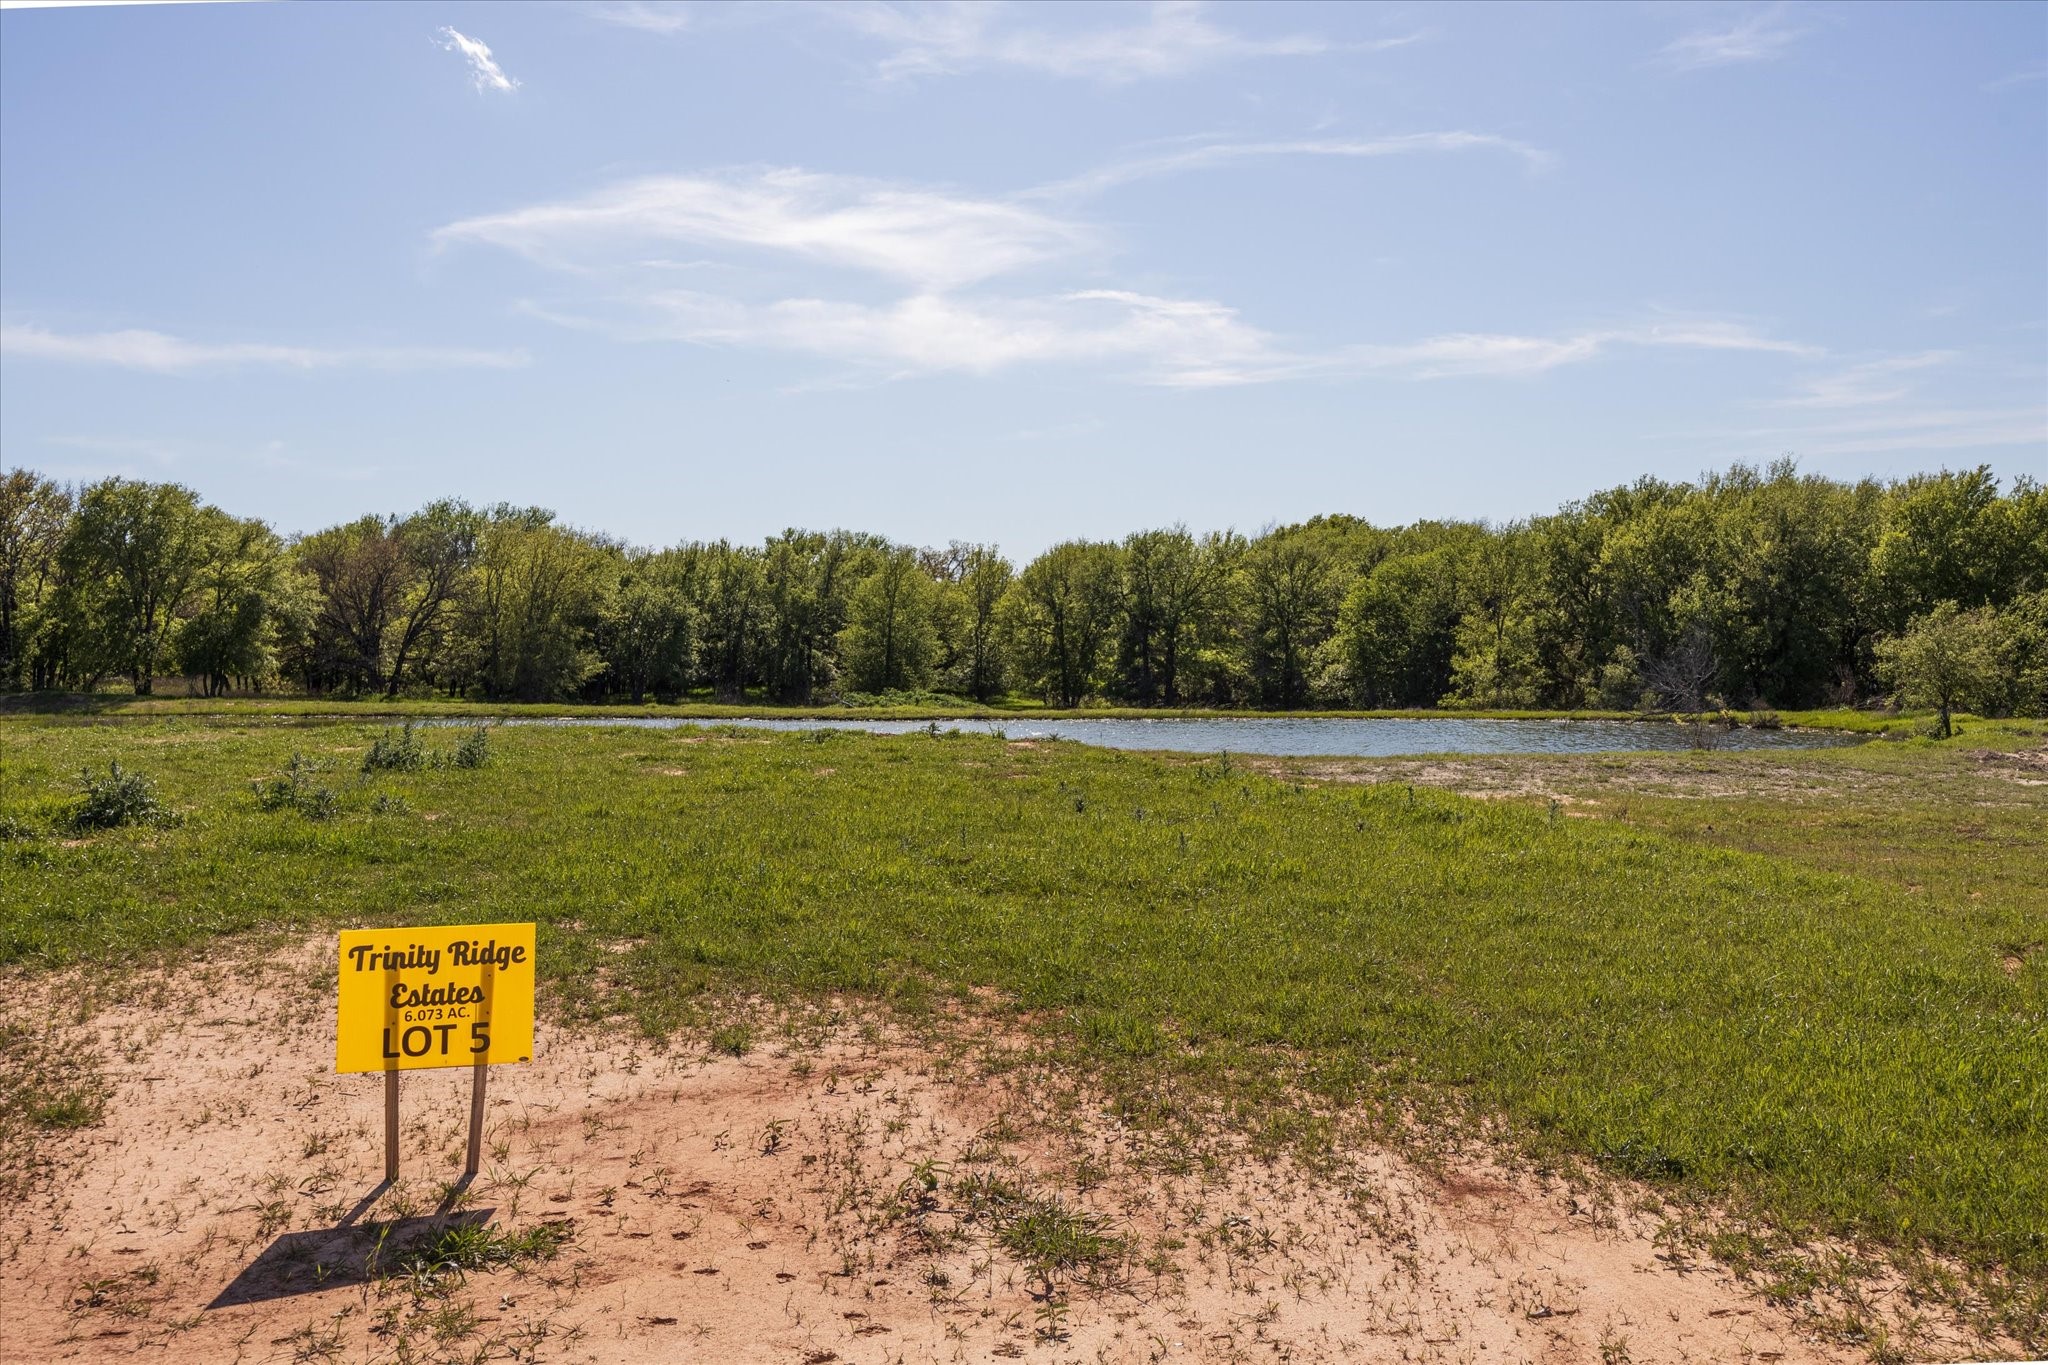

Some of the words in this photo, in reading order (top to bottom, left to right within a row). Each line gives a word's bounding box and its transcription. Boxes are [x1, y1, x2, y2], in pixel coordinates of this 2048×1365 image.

[348, 944, 441, 975] Trinity
[447, 940, 527, 971] Ridge
[390, 982, 485, 1009] Estates
[404, 1008, 443, 1022] 6.073
[447, 1007, 470, 1019] AC.
[382, 1024, 457, 1058] LOT
[470, 1022, 491, 1053] 5
